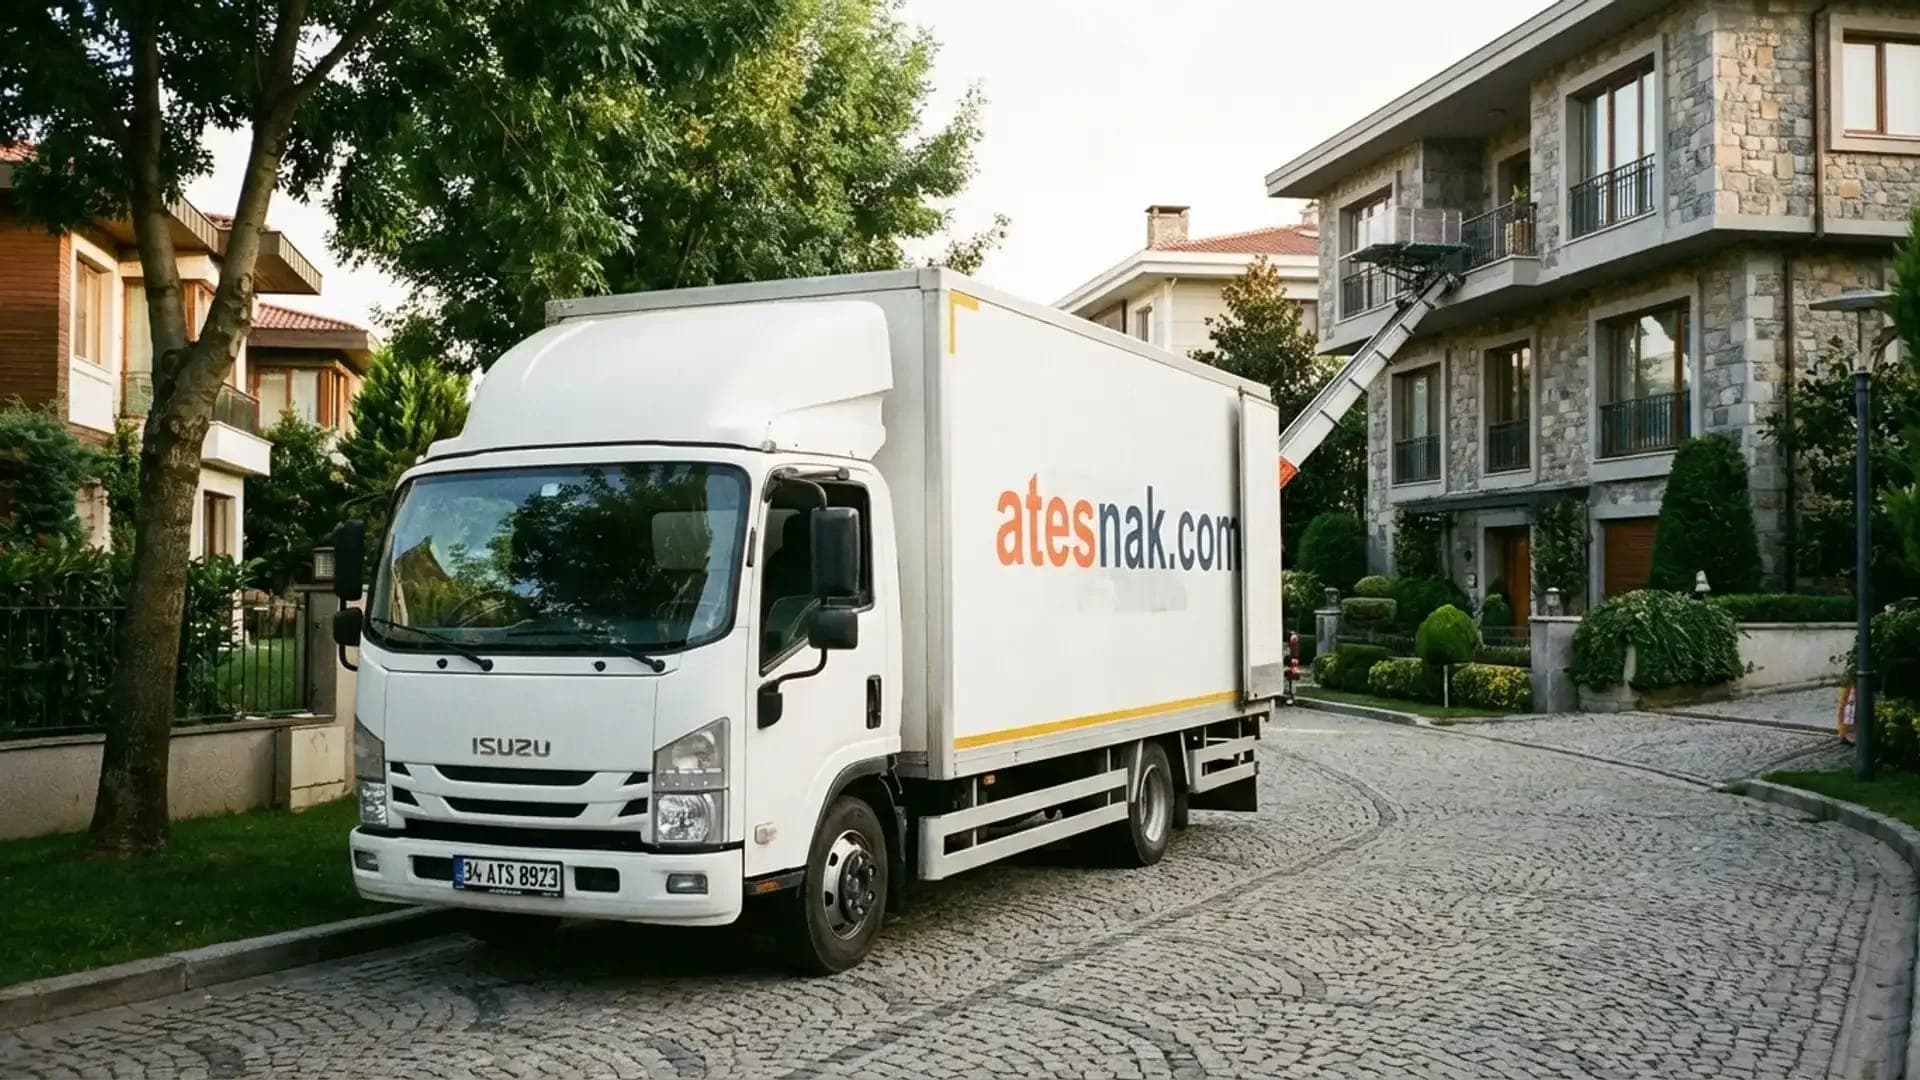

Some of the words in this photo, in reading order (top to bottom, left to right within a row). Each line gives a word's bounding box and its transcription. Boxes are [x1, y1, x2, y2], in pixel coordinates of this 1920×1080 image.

[996, 473, 1240, 571] atesnak.com
[472, 737, 550, 757] ISUZU
[464, 861, 482, 882] 34
[486, 864, 515, 885] ATS
